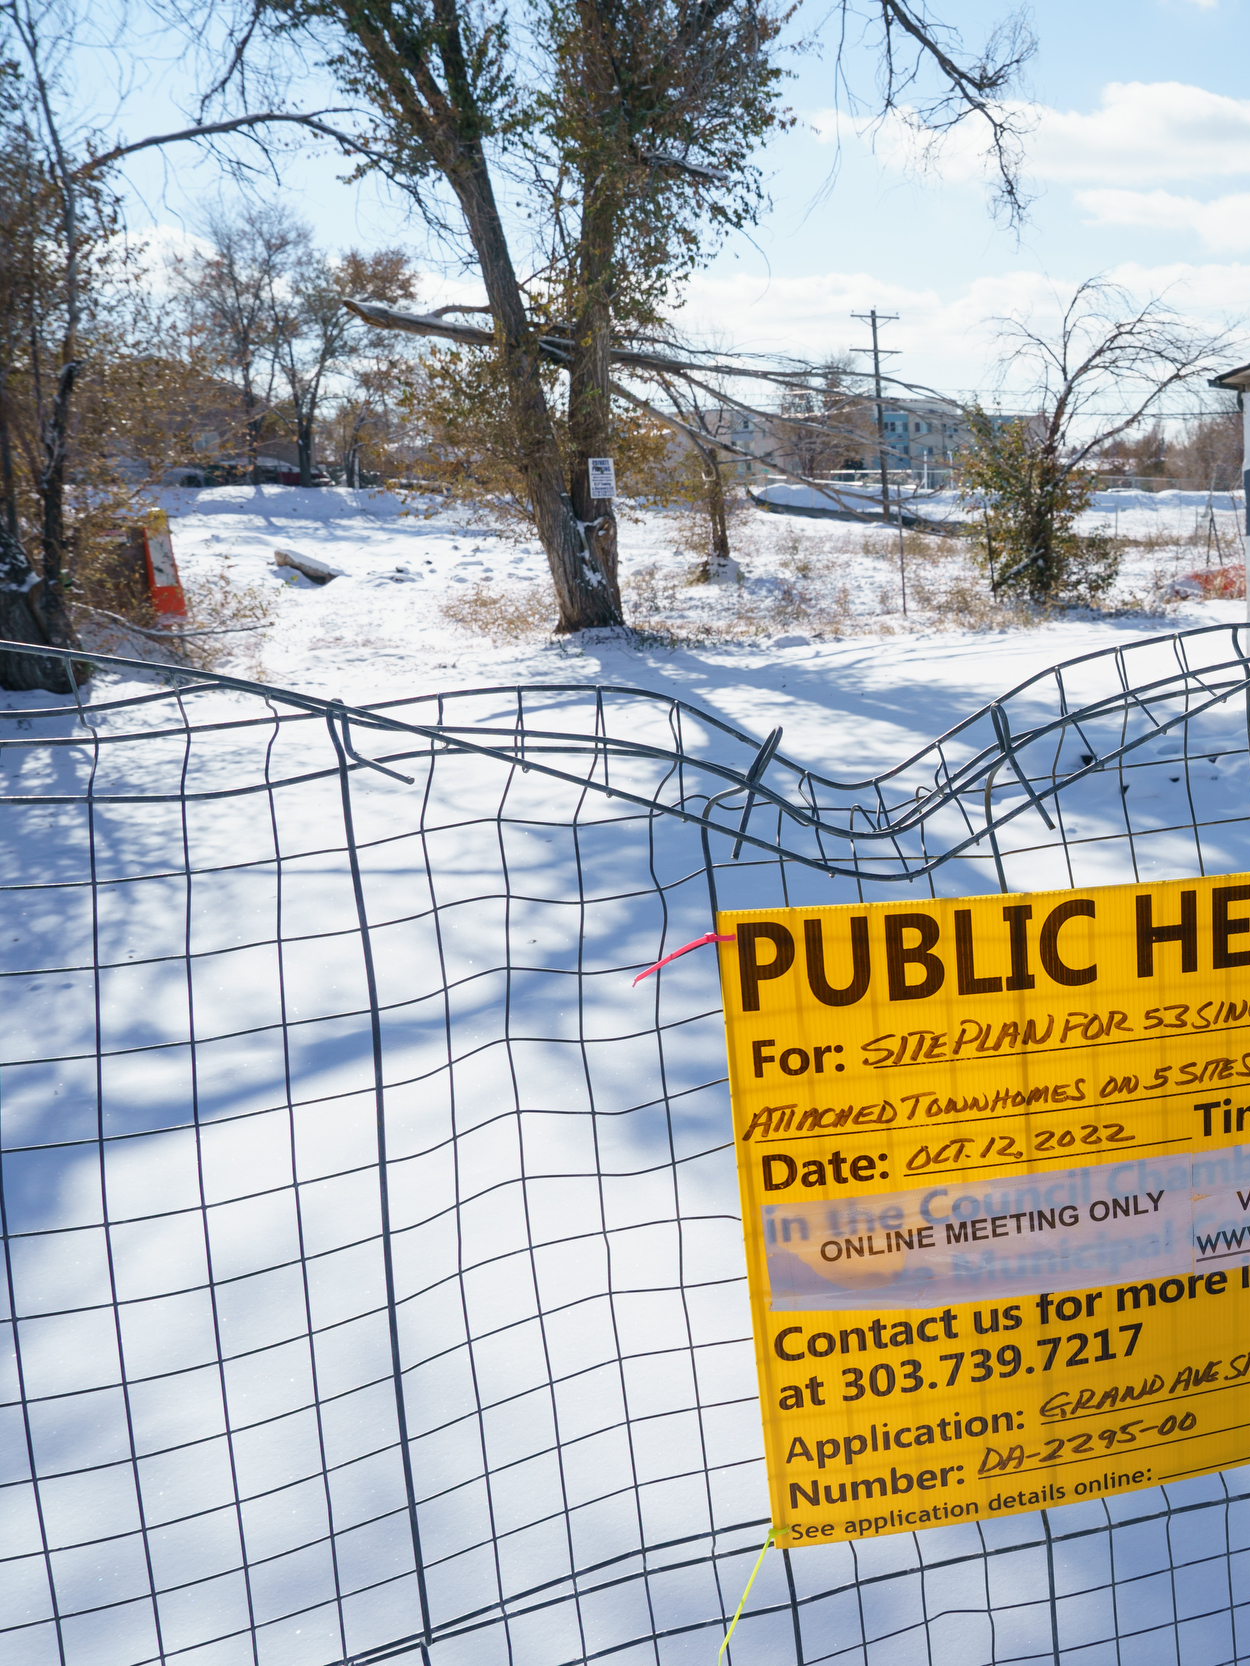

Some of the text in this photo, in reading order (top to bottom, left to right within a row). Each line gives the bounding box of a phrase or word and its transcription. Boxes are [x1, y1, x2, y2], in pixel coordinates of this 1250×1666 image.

[737, 900, 1097, 1012] PUBLIC
[752, 1039, 845, 1078] For:
[860, 1029, 948, 1067] SITE
[952, 1014, 1054, 1056] PLAN
[1060, 1010, 1134, 1042] FOR
[1143, 1004, 1191, 1029] 53
[742, 1099, 897, 1142] ATTACHED
[900, 1077, 1086, 1120] TOWNHOMES
[1099, 1075, 1139, 1098] ON
[1143, 1065, 1173, 1089] 5
[1033, 1122, 1136, 1152] 2022
[762, 1150, 890, 1192] Date:
[820, 1225, 936, 1262] ONLINE
[945, 1205, 1079, 1245] MEETING
[1089, 1190, 1165, 1222] ONLY
[774, 1308, 959, 1361] Contact
[973, 1302, 1023, 1334] us
[1036, 1292, 1102, 1325] for
[1117, 1270, 1226, 1312] more
[778, 1322, 1143, 1410] at 303.739.7217
[1039, 1374, 1164, 1419] GRAND
[1169, 1360, 1222, 1394] AVE
[785, 1407, 1024, 1469] Application:
[977, 1411, 1197, 1475] DA-2295-00
[789, 1464, 964, 1509] Number:
[791, 1468, 1152, 1541] See application details online:
